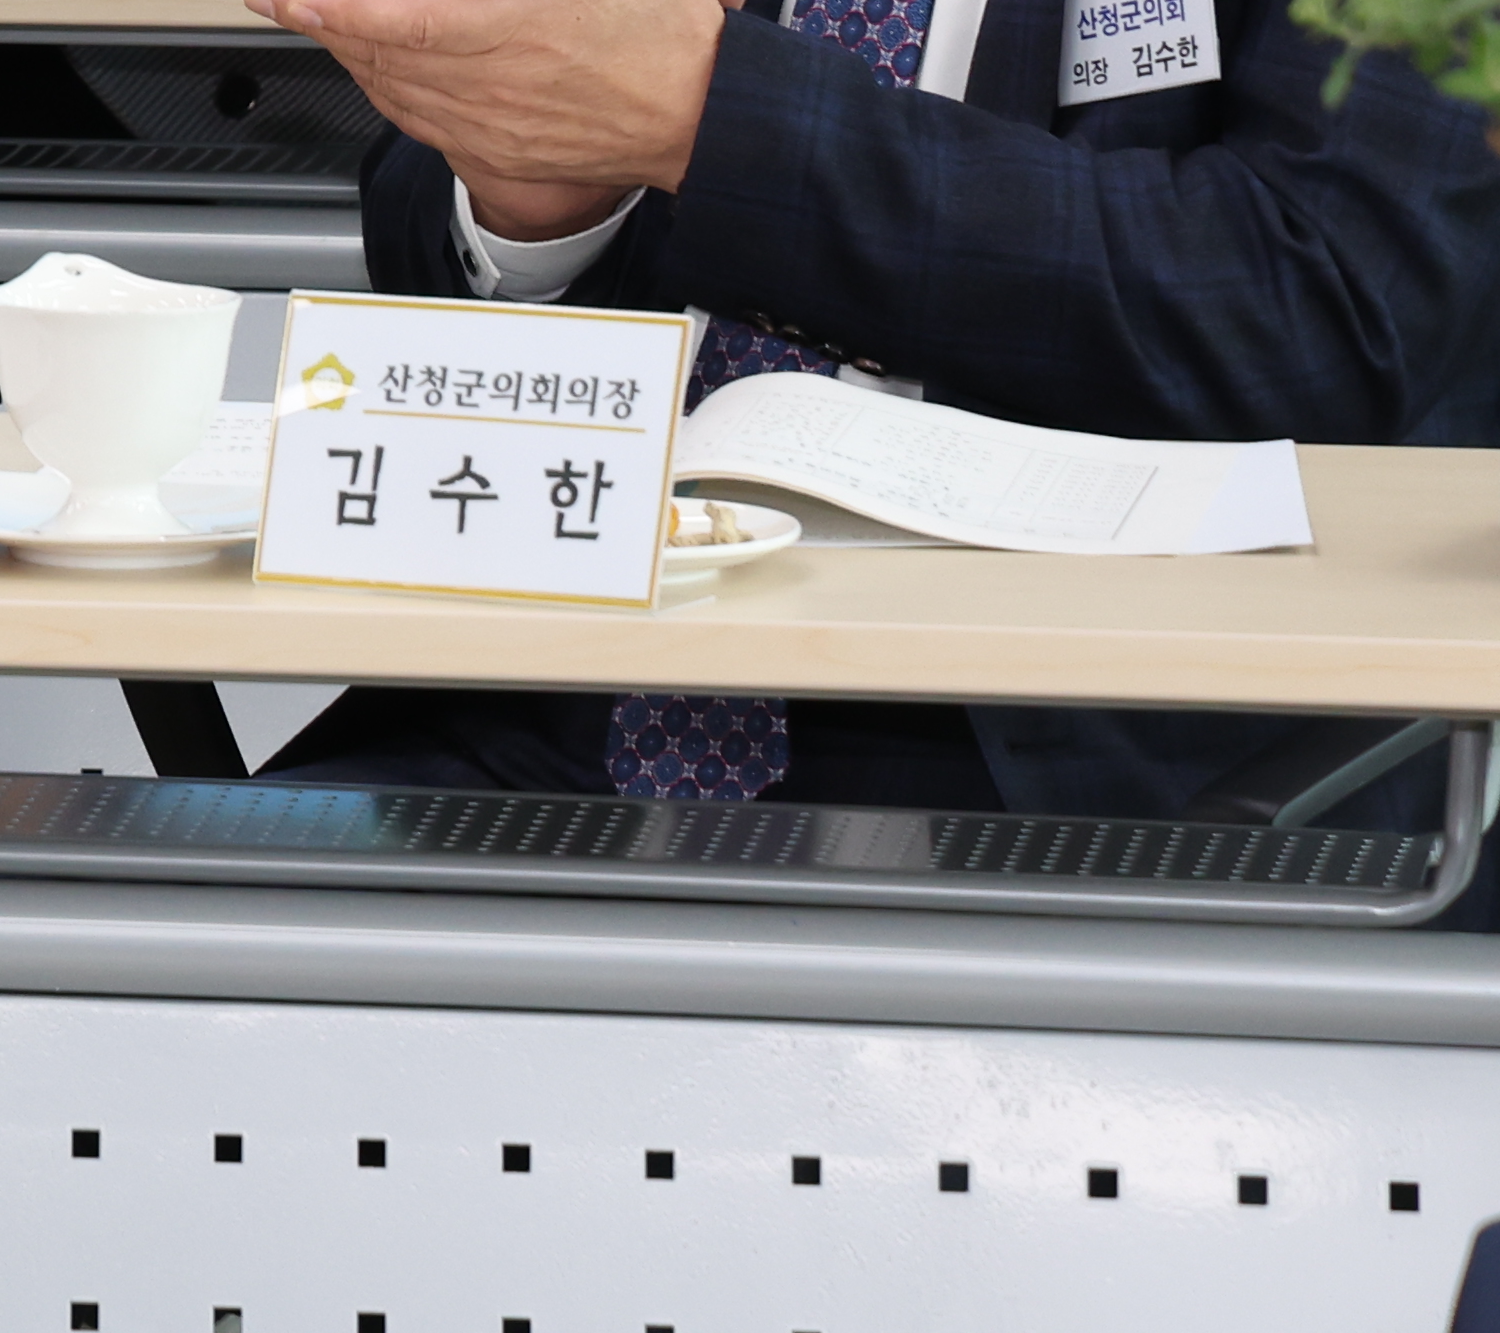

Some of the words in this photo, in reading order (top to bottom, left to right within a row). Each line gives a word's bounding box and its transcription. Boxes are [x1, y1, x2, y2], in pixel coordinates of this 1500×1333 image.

[1073, 57, 1109, 87] 의장
[1132, 35, 1199, 78] 김수한
[377, 363, 642, 421] 산청군의회의장
